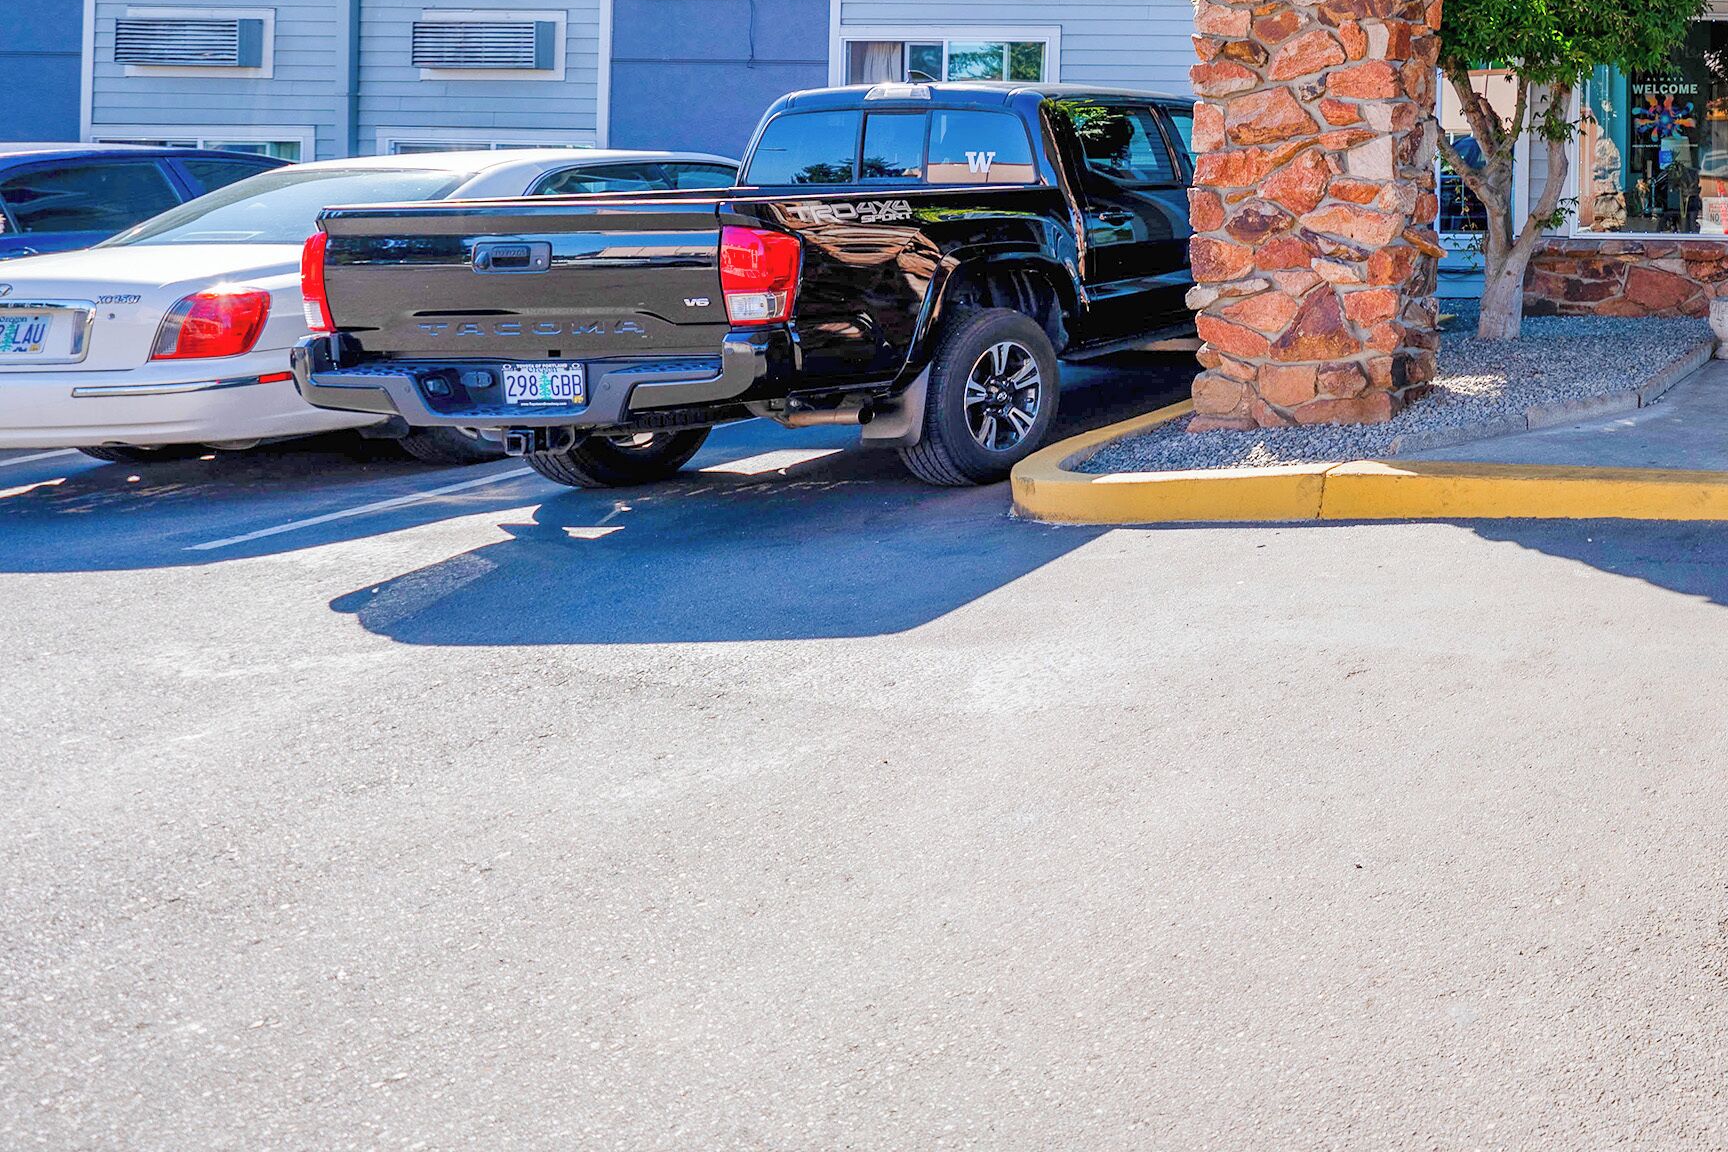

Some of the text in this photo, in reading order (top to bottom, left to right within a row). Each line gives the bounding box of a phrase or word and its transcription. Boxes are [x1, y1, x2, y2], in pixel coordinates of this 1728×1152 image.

[1632, 84, 1698, 95] WELCOME
[964, 151, 996, 174] W
[786, 203, 859, 224] TRD
[860, 212, 913, 223] SPORT
[683, 297, 709, 307] V6
[12, 323, 46, 345] LAU
[416, 321, 645, 336] TACOMA
[506, 374, 582, 397] 298 GBB
